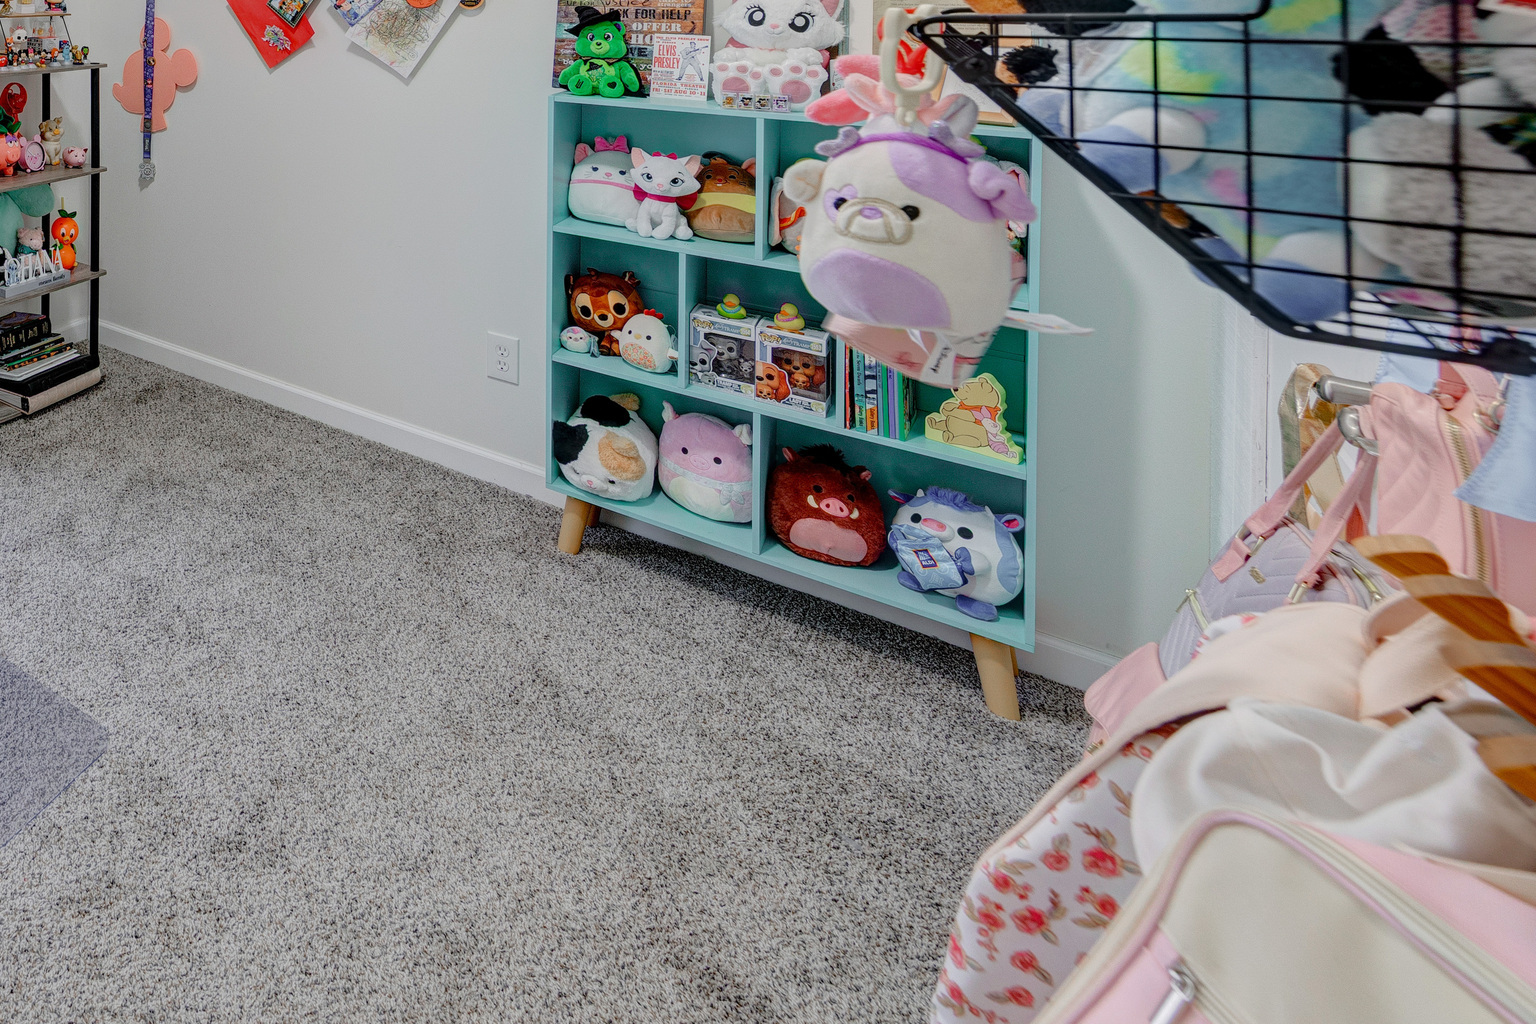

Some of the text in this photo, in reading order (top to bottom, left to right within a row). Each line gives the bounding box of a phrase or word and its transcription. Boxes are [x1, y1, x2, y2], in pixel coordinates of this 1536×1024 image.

[635, 9, 656, 19] FOR
[661, 9, 691, 20] HELP
[631, 22, 682, 32] OFFER
[658, 45, 677, 56] ELVIS
[654, 57, 680, 69] PRESLEY
[5, 246, 64, 286] OHANA
[694, 319, 713, 330] POP!
[760, 333, 781, 344] POP!
